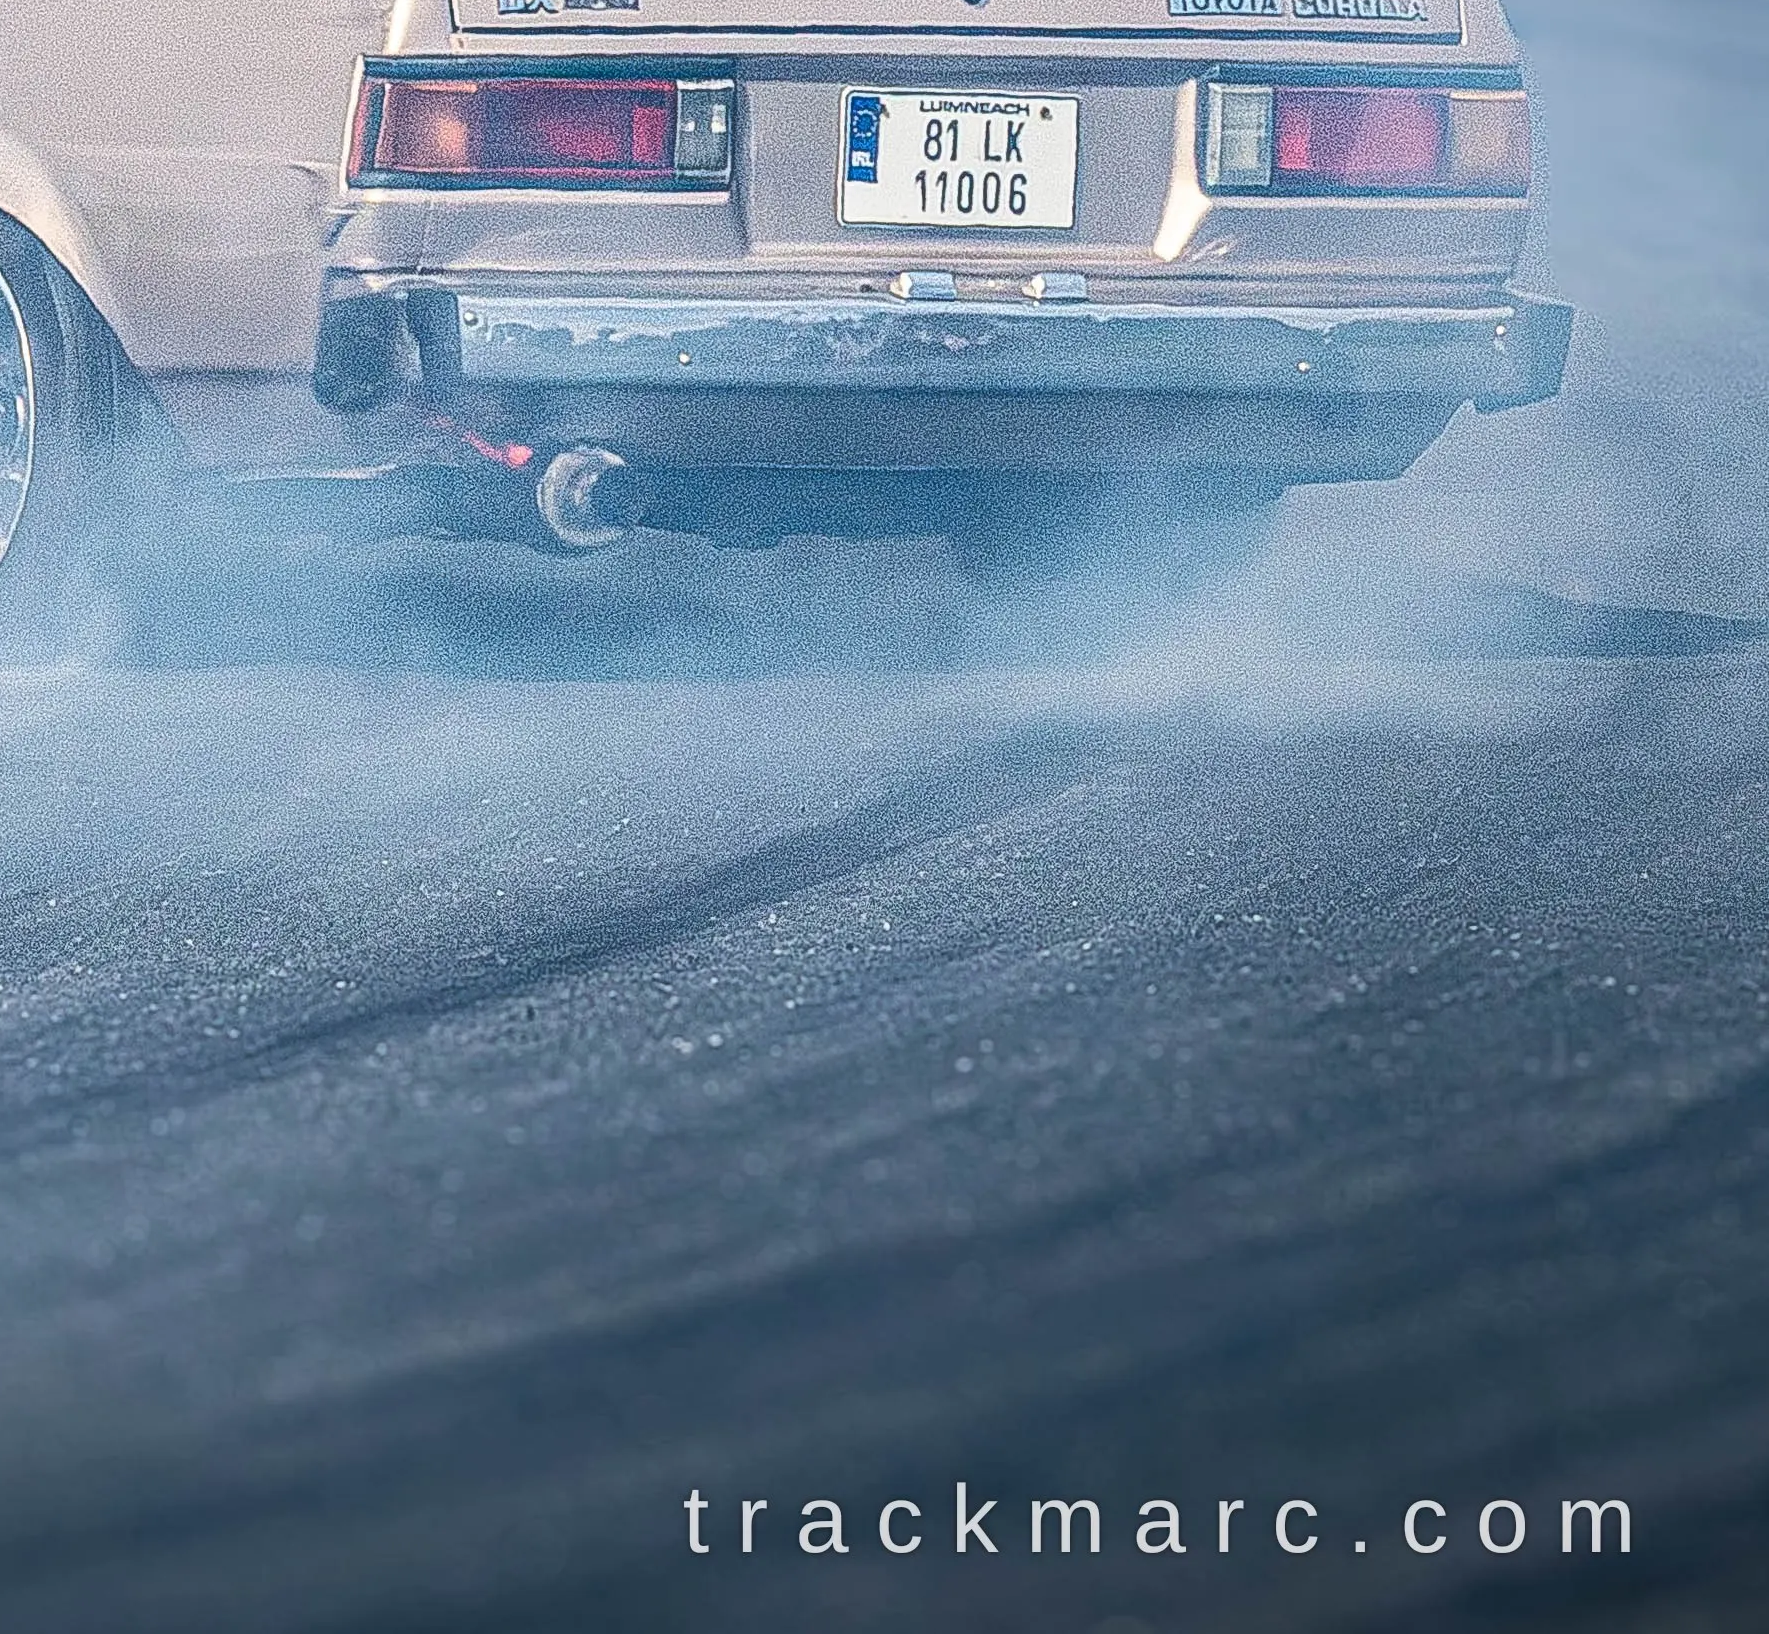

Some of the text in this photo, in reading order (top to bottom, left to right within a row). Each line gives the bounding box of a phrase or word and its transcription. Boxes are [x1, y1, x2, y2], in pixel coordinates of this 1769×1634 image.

[919, 100, 1030, 116] LUIMNEACH
[924, 119, 1025, 162] 81 LK
[915, 169, 1028, 215] 11006
